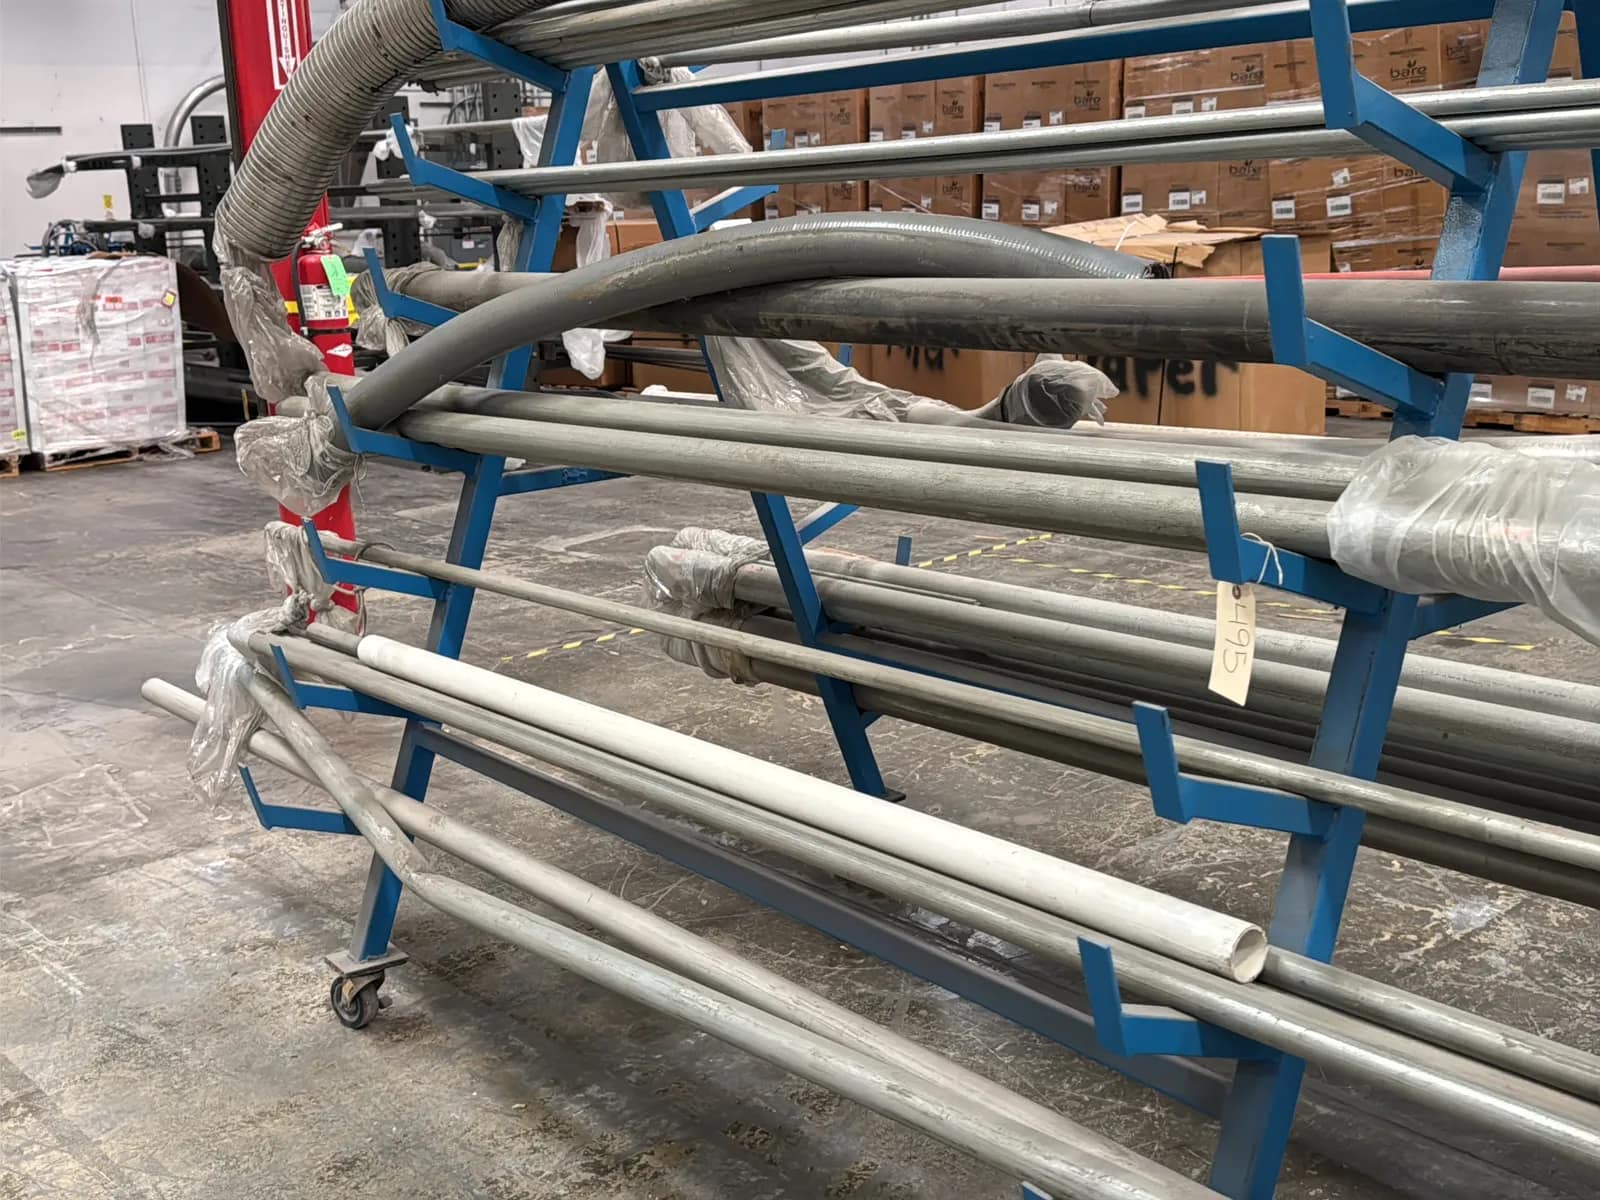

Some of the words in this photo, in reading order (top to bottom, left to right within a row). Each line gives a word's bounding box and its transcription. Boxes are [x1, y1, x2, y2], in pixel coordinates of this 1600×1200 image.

[280, 0, 291, 73] TINGUISHER
[1390, 65, 1427, 78] bare
[1222, 602, 1250, 674] 495
